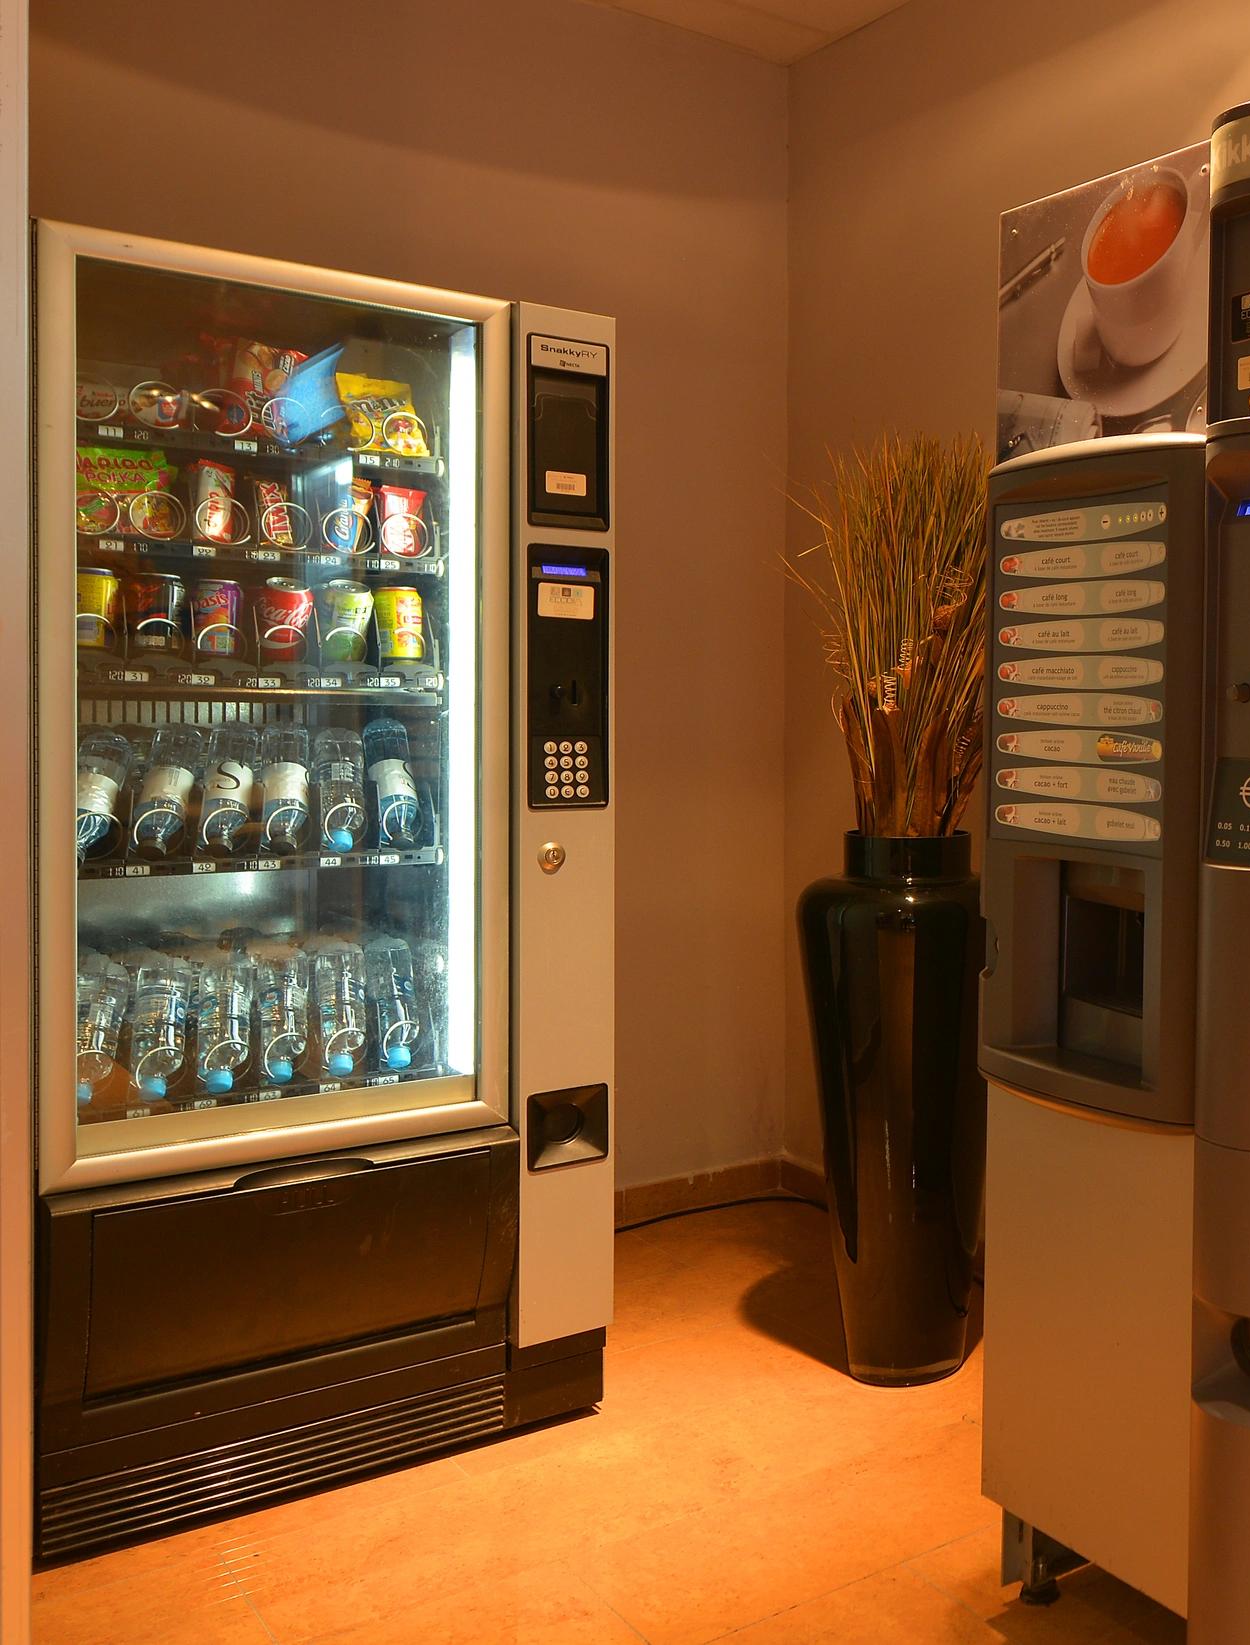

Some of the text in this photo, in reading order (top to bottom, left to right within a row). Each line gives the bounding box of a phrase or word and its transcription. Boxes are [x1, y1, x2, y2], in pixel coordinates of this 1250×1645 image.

[540, 344, 598, 359] SnakkyRY
[384, 457, 400, 467] 210
[384, 561, 396, 569] 25
[1041, 556, 1071, 565] café court
[1041, 593, 1068, 602] café long
[108, 670, 124, 681] 120
[131, 672, 143, 680] 31
[177, 674, 192, 684] 120
[198, 676, 210, 684] 32
[263, 679, 275, 687] 33
[307, 677, 320, 687] 120
[367, 677, 379, 687] 120
[384, 678, 396, 686] 35
[1036, 703, 1069, 711] cappuccino
[1033, 780, 1051, 788] cacao
[1033, 817, 1051, 825] cacao
[1217, 821, 1233, 831] 0.05
[1215, 839, 1231, 848] 0.50
[263, 860, 276, 868] 43
[325, 857, 336, 866] 44
[132, 866, 145, 875] 41
[198, 863, 211, 872] 42
[382, 1076, 395, 1085] 65
[323, 1084, 336, 1092] 64
